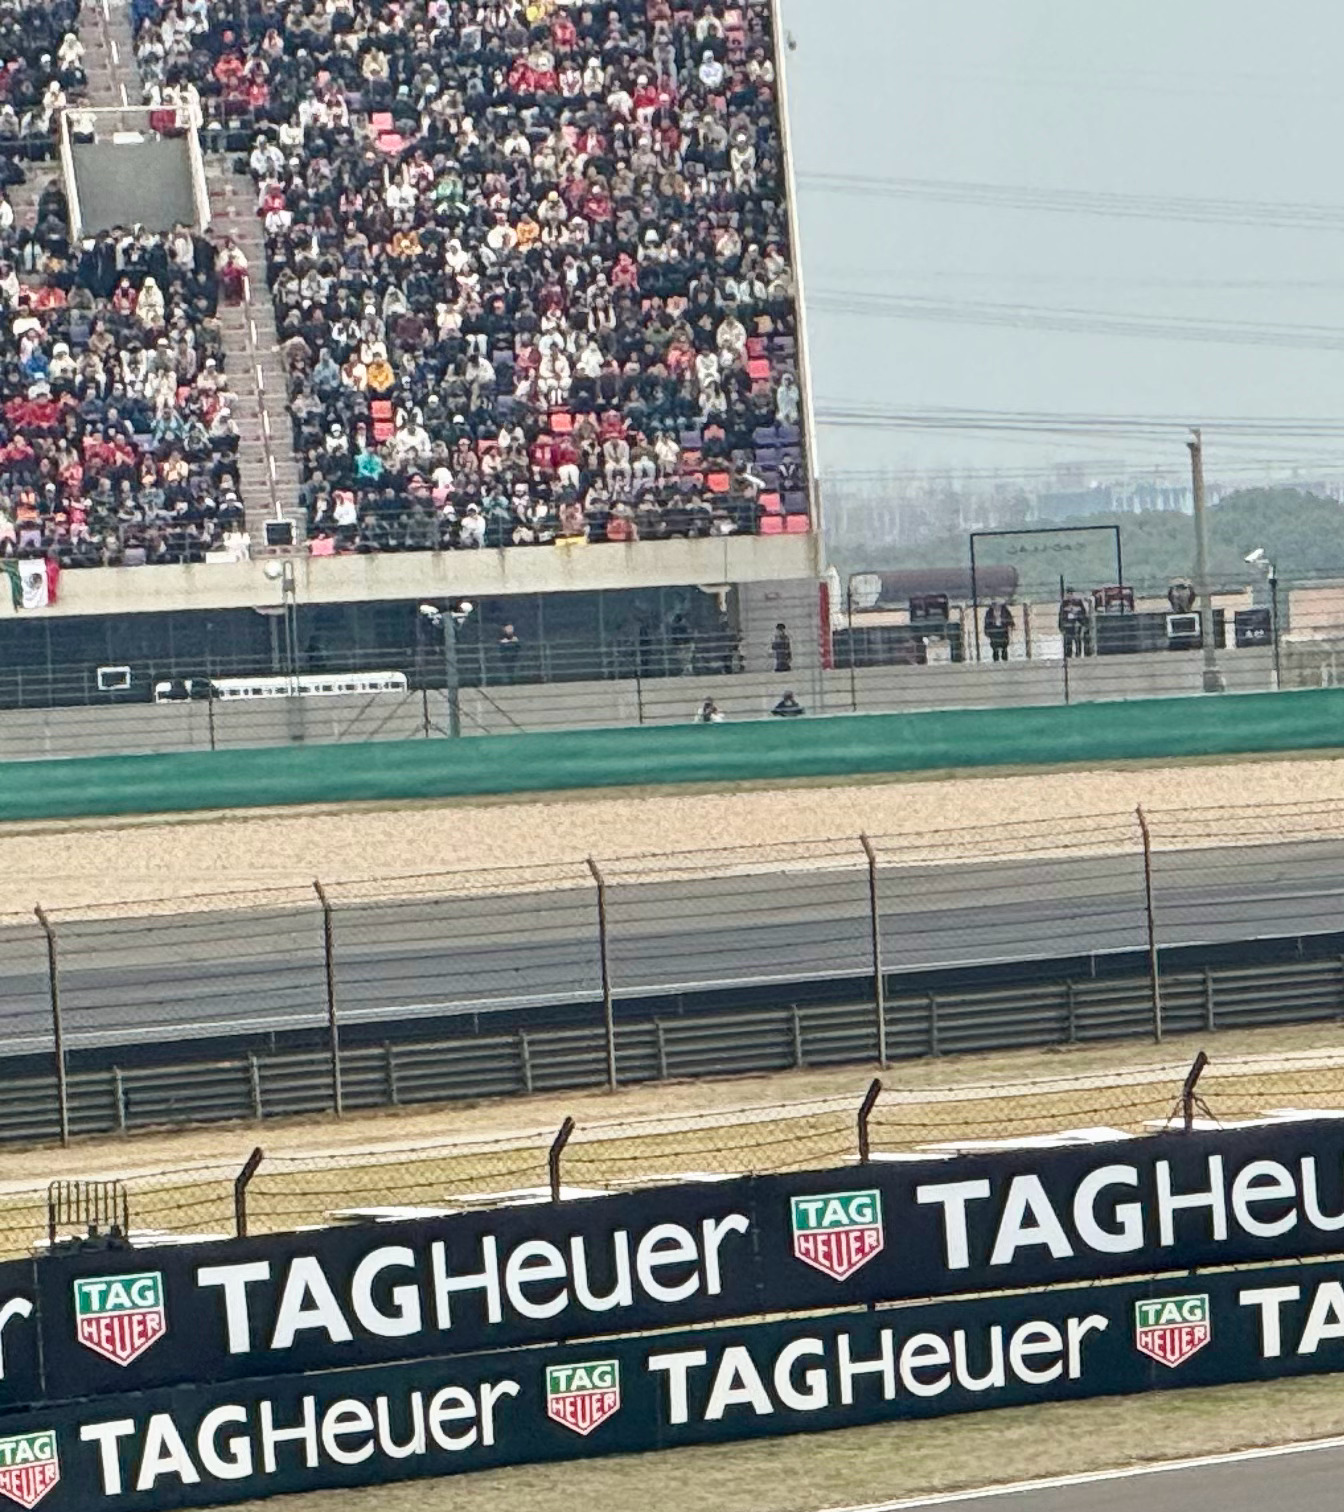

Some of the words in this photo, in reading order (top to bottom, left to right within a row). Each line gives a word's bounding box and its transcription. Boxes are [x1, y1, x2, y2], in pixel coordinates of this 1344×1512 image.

[796, 1194, 874, 1224] TAG
[796, 1224, 880, 1271] HEUER
[82, 1280, 156, 1311] TAG
[198, 1213, 750, 1353] TAGHeuer
[1142, 1298, 1205, 1326] TAG
[82, 1312, 162, 1359] HEUER
[1140, 1326, 1208, 1361] HEUER
[553, 1365, 614, 1392] TAG
[648, 1316, 1109, 1424] TAGHeuer
[551, 1391, 617, 1427] HEUER
[0, 1437, 51, 1465] TAG
[80, 1379, 520, 1496] TAGHeuer
